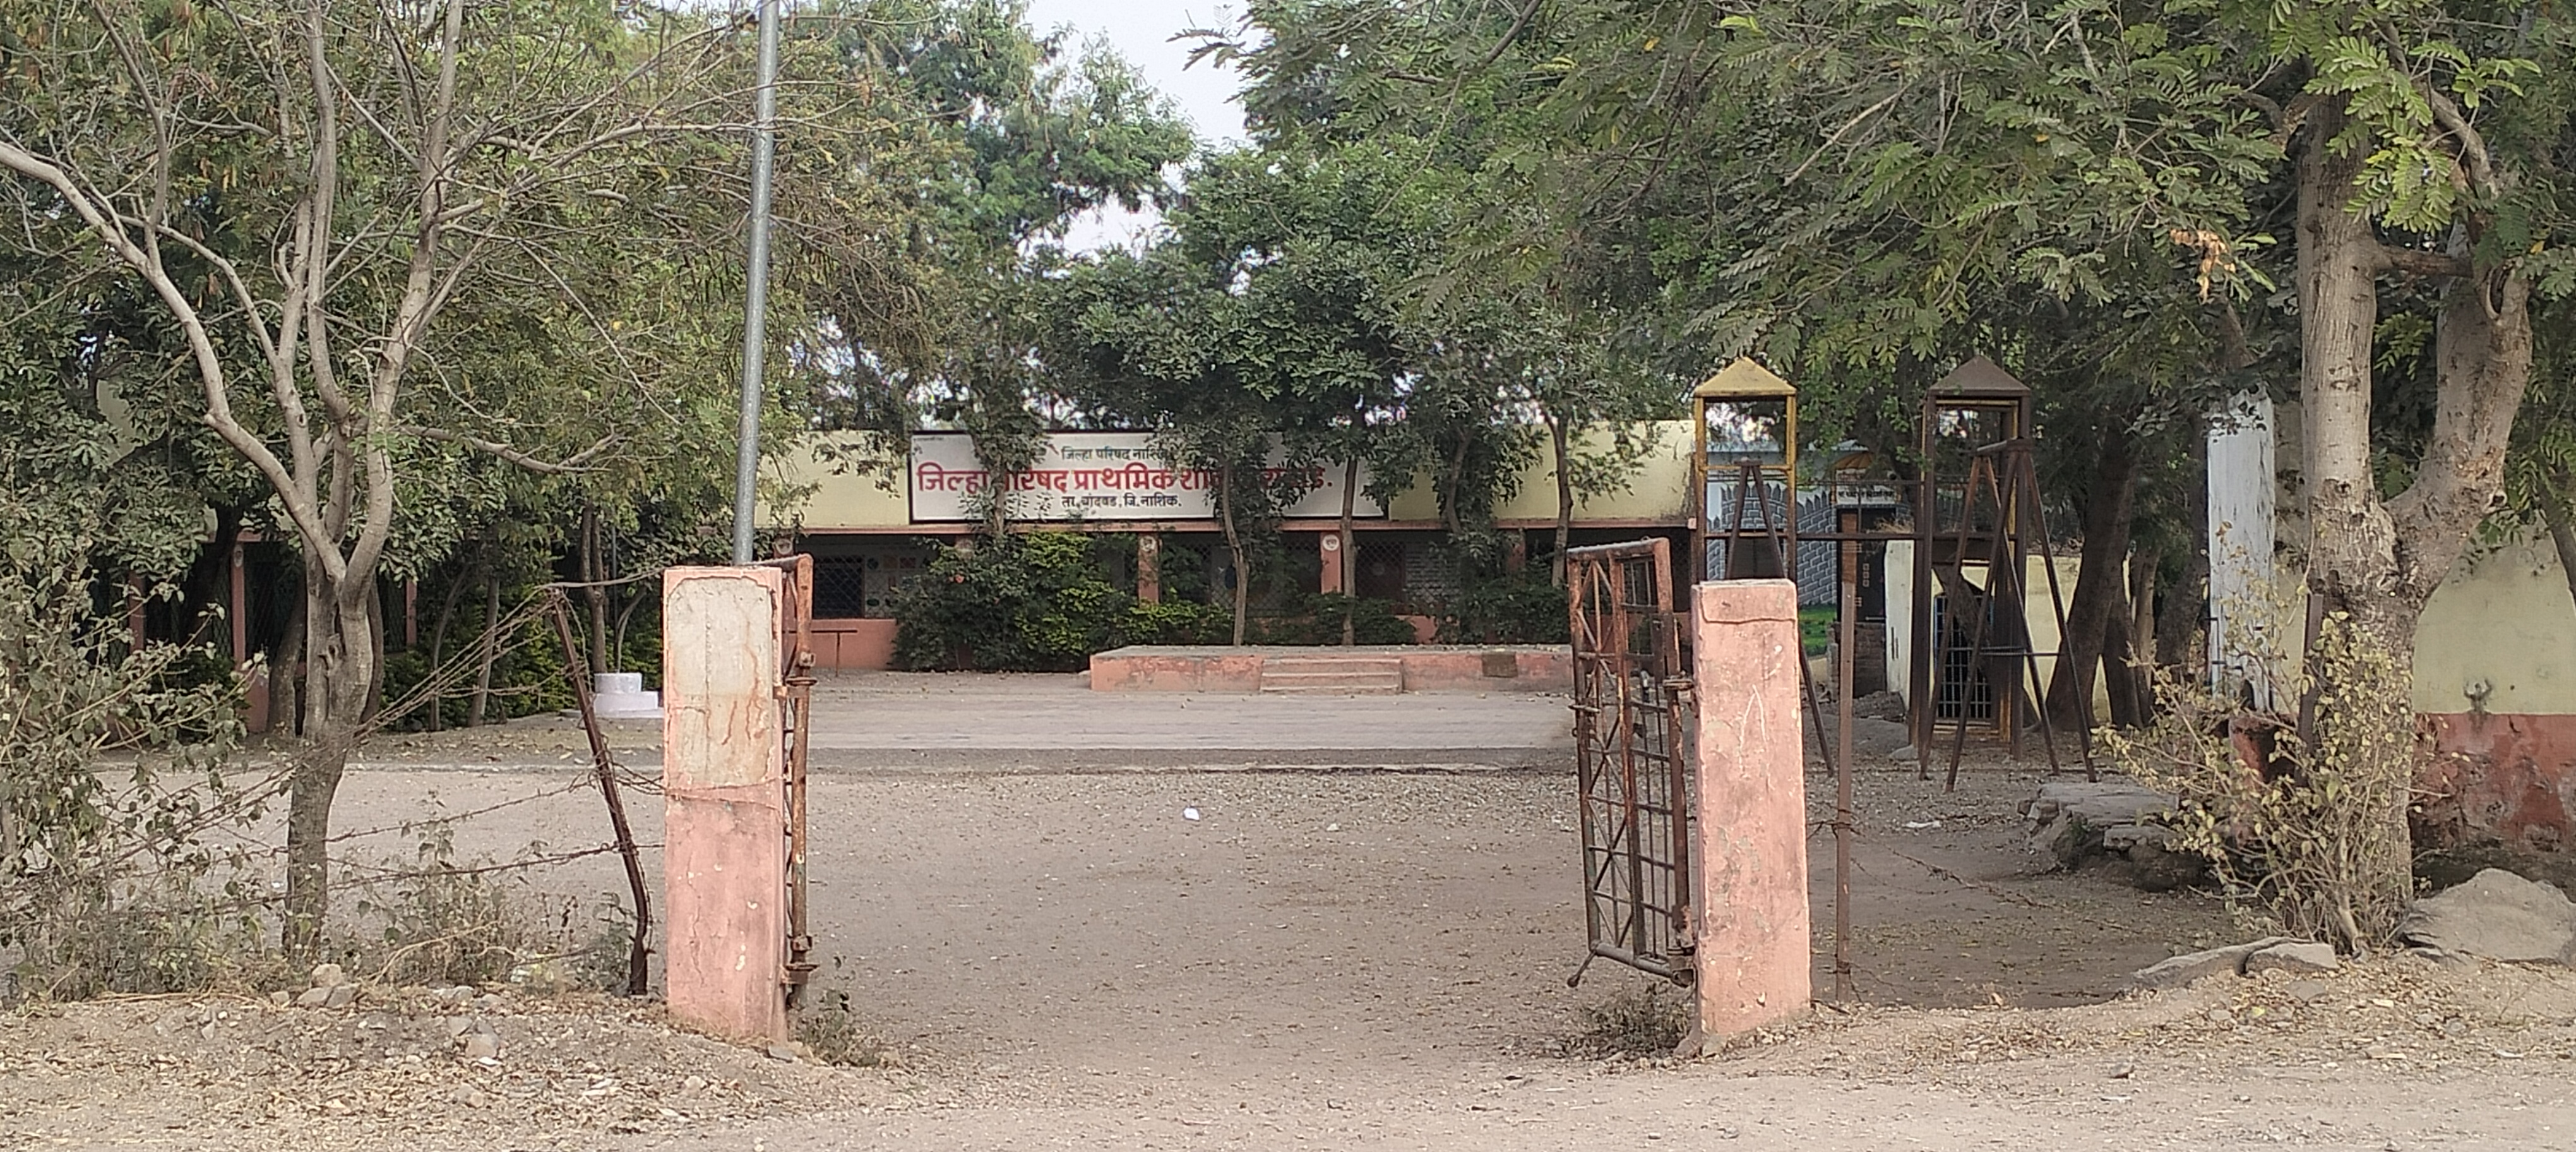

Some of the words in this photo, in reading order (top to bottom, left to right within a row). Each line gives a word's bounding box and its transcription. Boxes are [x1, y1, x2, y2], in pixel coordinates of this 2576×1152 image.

[1061, 446, 1092, 460] जिल्हा
[1095, 446, 1131, 460] परिषद
[1133, 445, 1174, 461] नाशि
[917, 462, 989, 494] जिल्हा
[993, 467, 1069, 493] रिषद
[1072, 462, 1176, 491] प्राथमिक
